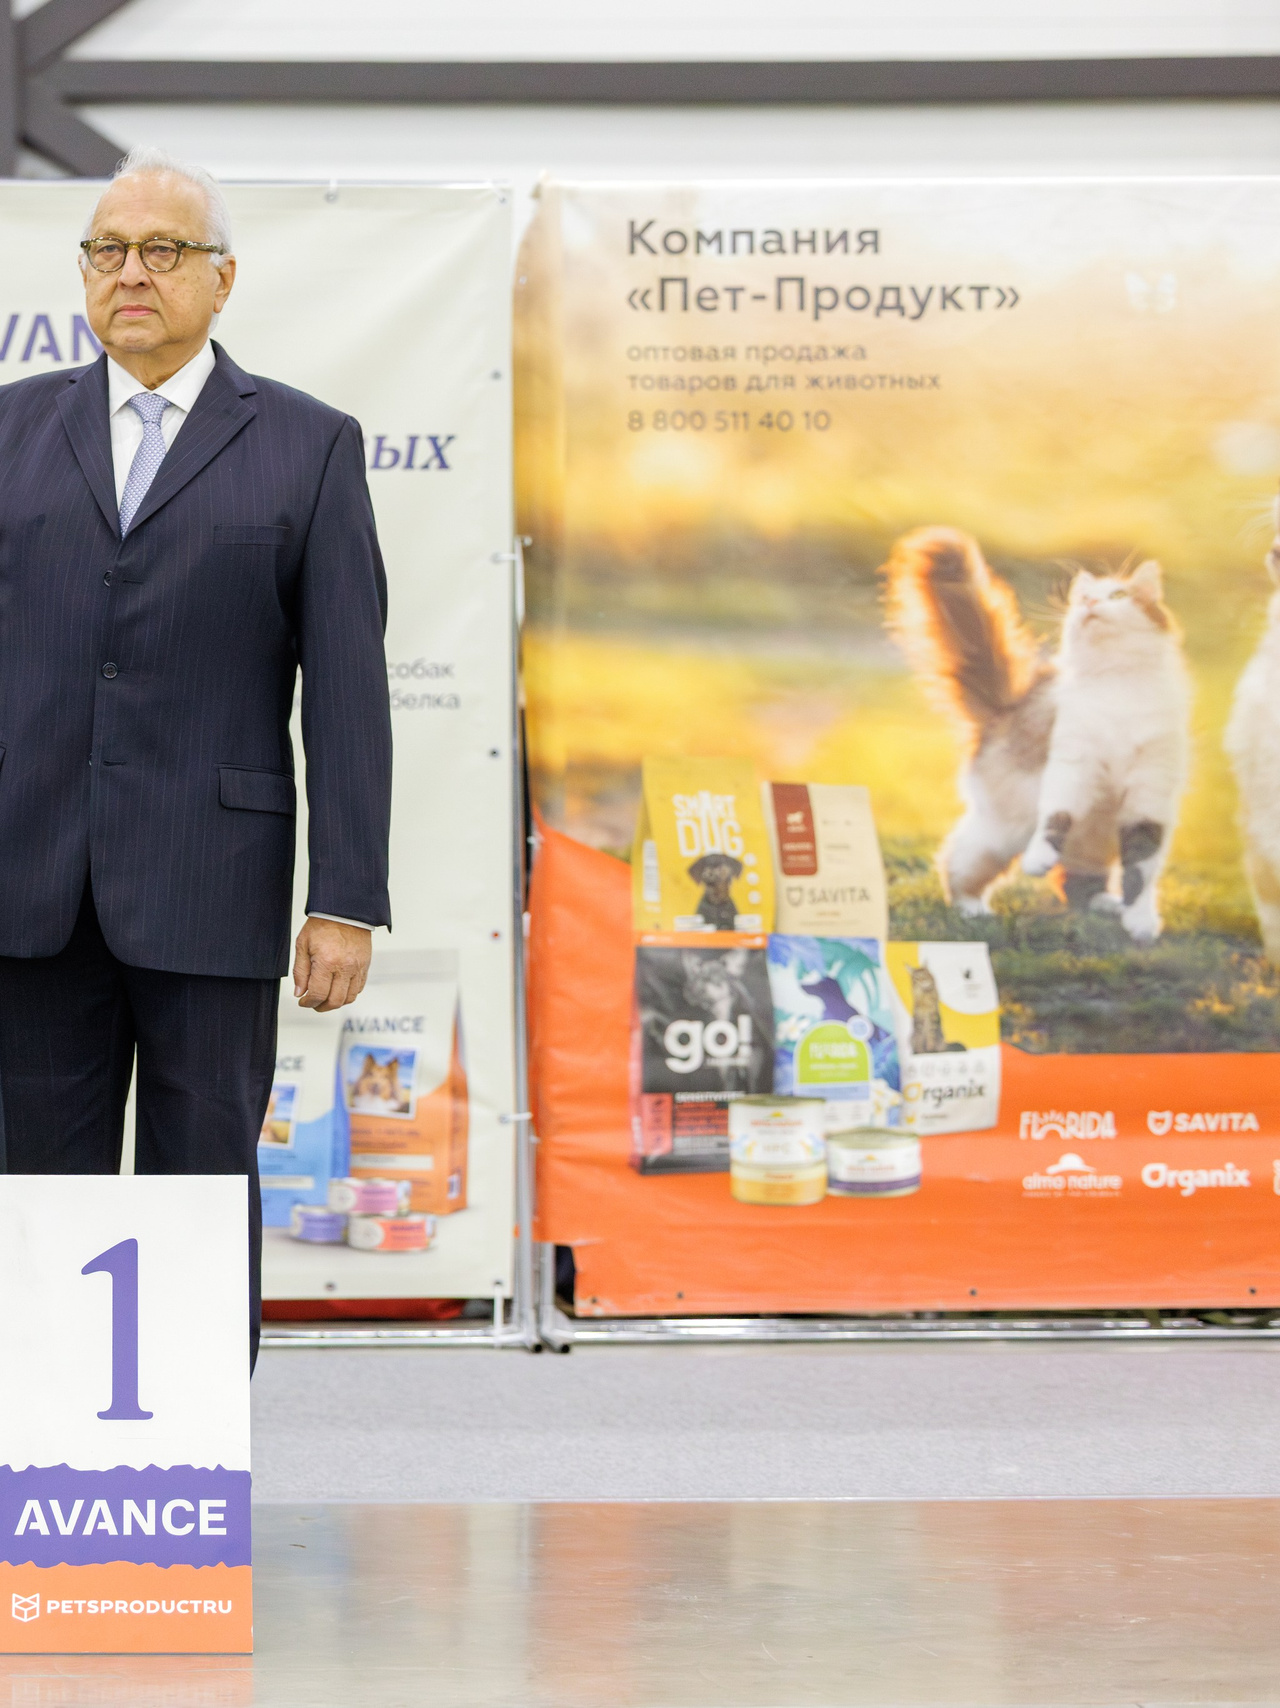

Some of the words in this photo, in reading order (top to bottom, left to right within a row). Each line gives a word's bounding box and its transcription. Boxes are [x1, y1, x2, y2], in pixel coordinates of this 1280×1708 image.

[628, 220, 881, 255] Компания
[627, 276, 1021, 320] «Пет-Продукт»
[627, 345, 737, 362] оптовая
[745, 345, 867, 365] продажа
[628, 373, 737, 394] товаров
[746, 373, 797, 393] для
[805, 373, 941, 391] животных
[628, 411, 644, 431] 8
[652, 411, 707, 431] 800
[713, 411, 751, 431] 511
[757, 411, 794, 431] 40
[802, 411, 832, 431] 10
[808, 886, 871, 905] SAVITA
[342, 1016, 425, 1034] AVANCE
[664, 1014, 752, 1074] go!
[1174, 1112, 1259, 1132] SAVITA
[1141, 1162, 1251, 1196] Organix
[81, 1238, 153, 1420] 1
[14, 1499, 227, 1536] AVANCE
[47, 1600, 232, 1614] PETSPRODUCTRU
